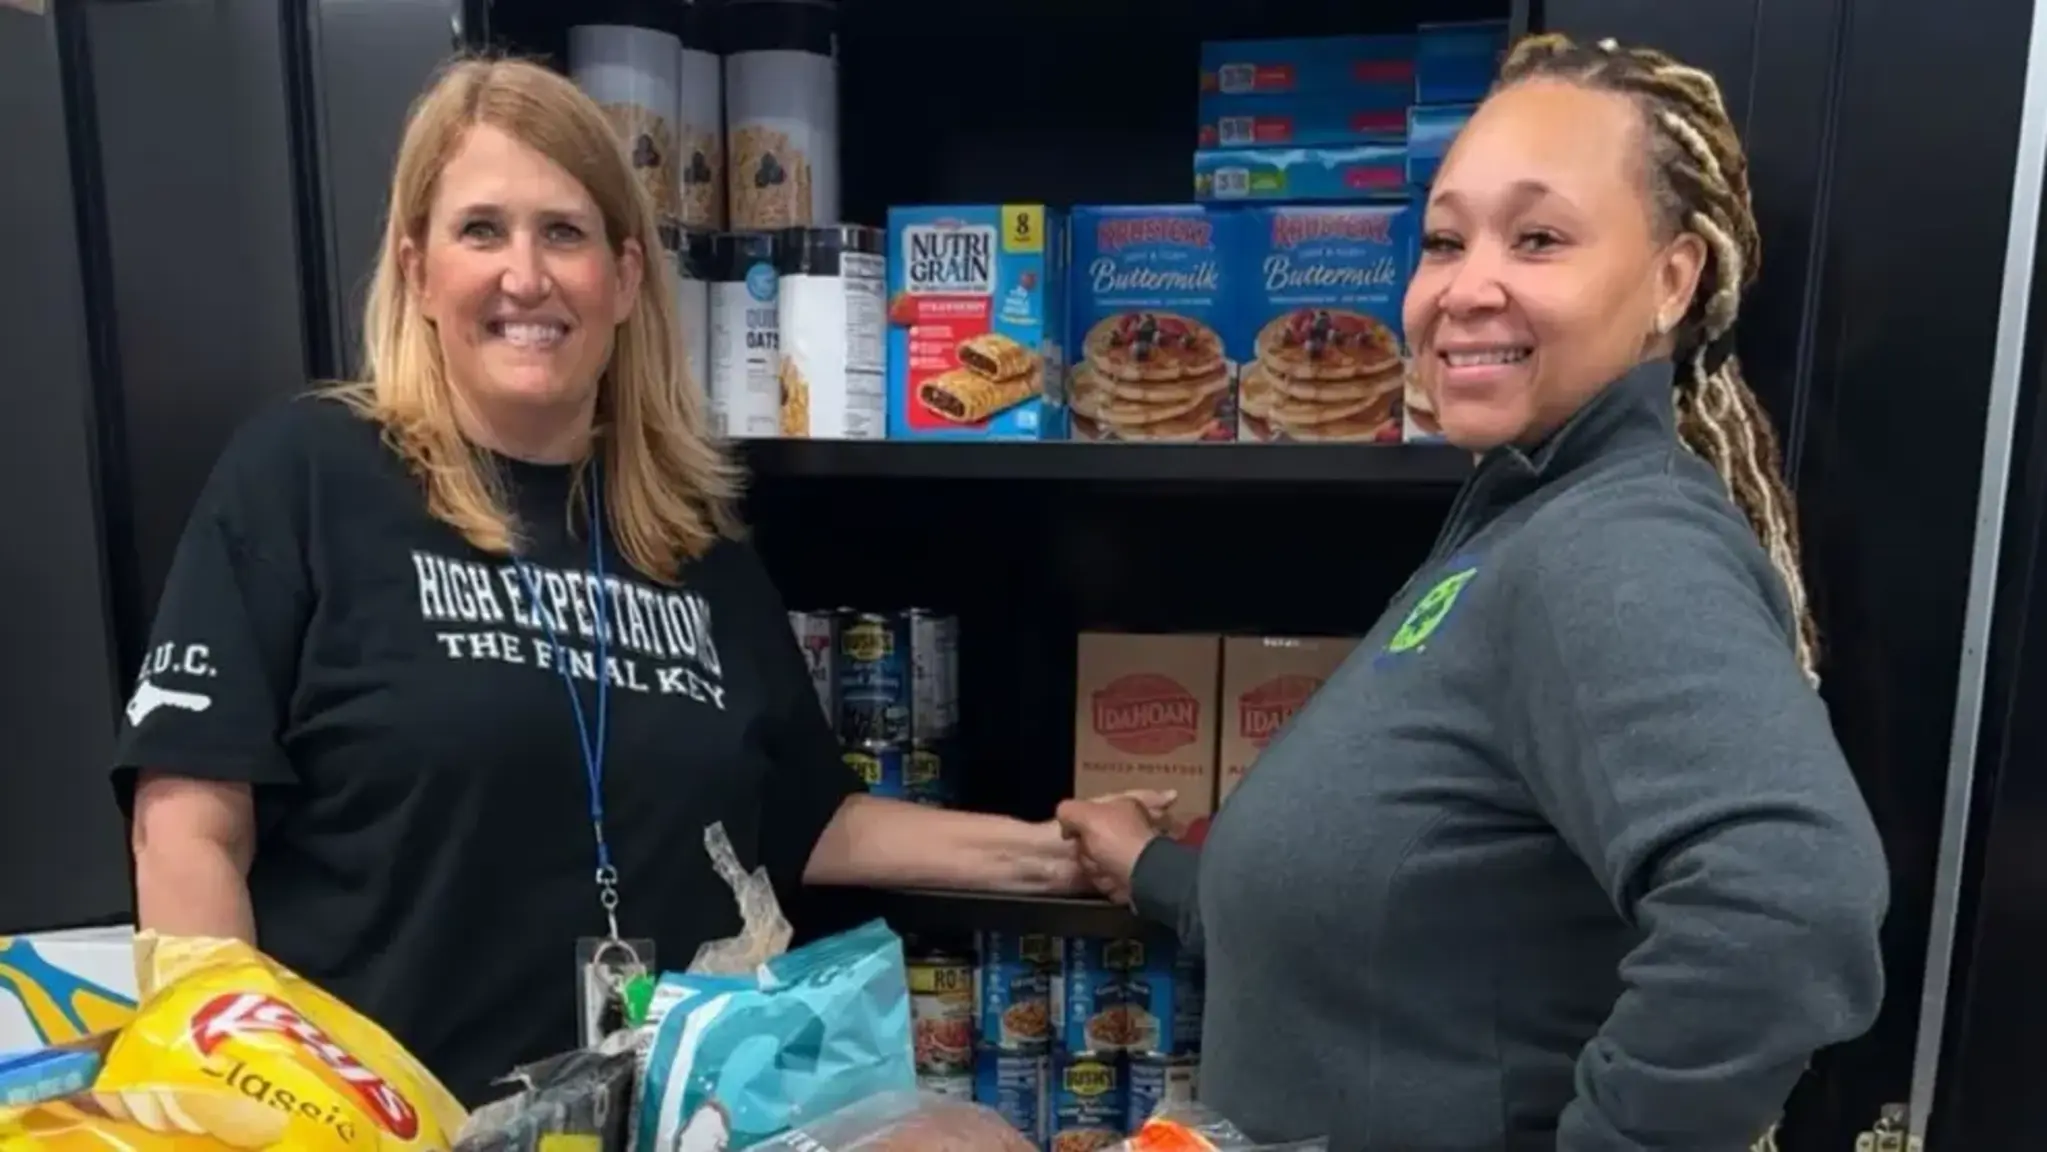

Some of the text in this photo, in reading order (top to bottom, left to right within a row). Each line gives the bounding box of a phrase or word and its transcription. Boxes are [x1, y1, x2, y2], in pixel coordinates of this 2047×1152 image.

[1016, 213, 1029, 234] 8
[911, 233, 989, 259] NUTRI
[910, 256, 988, 282] GRAIN
[1089, 257, 1218, 293] Buttermilk
[1263, 254, 1396, 291] Buttermilk
[412, 553, 504, 623] HIGH
[437, 632, 726, 710] THE FINAL KEY
[1095, 702, 1194, 734] IDAHOAN
